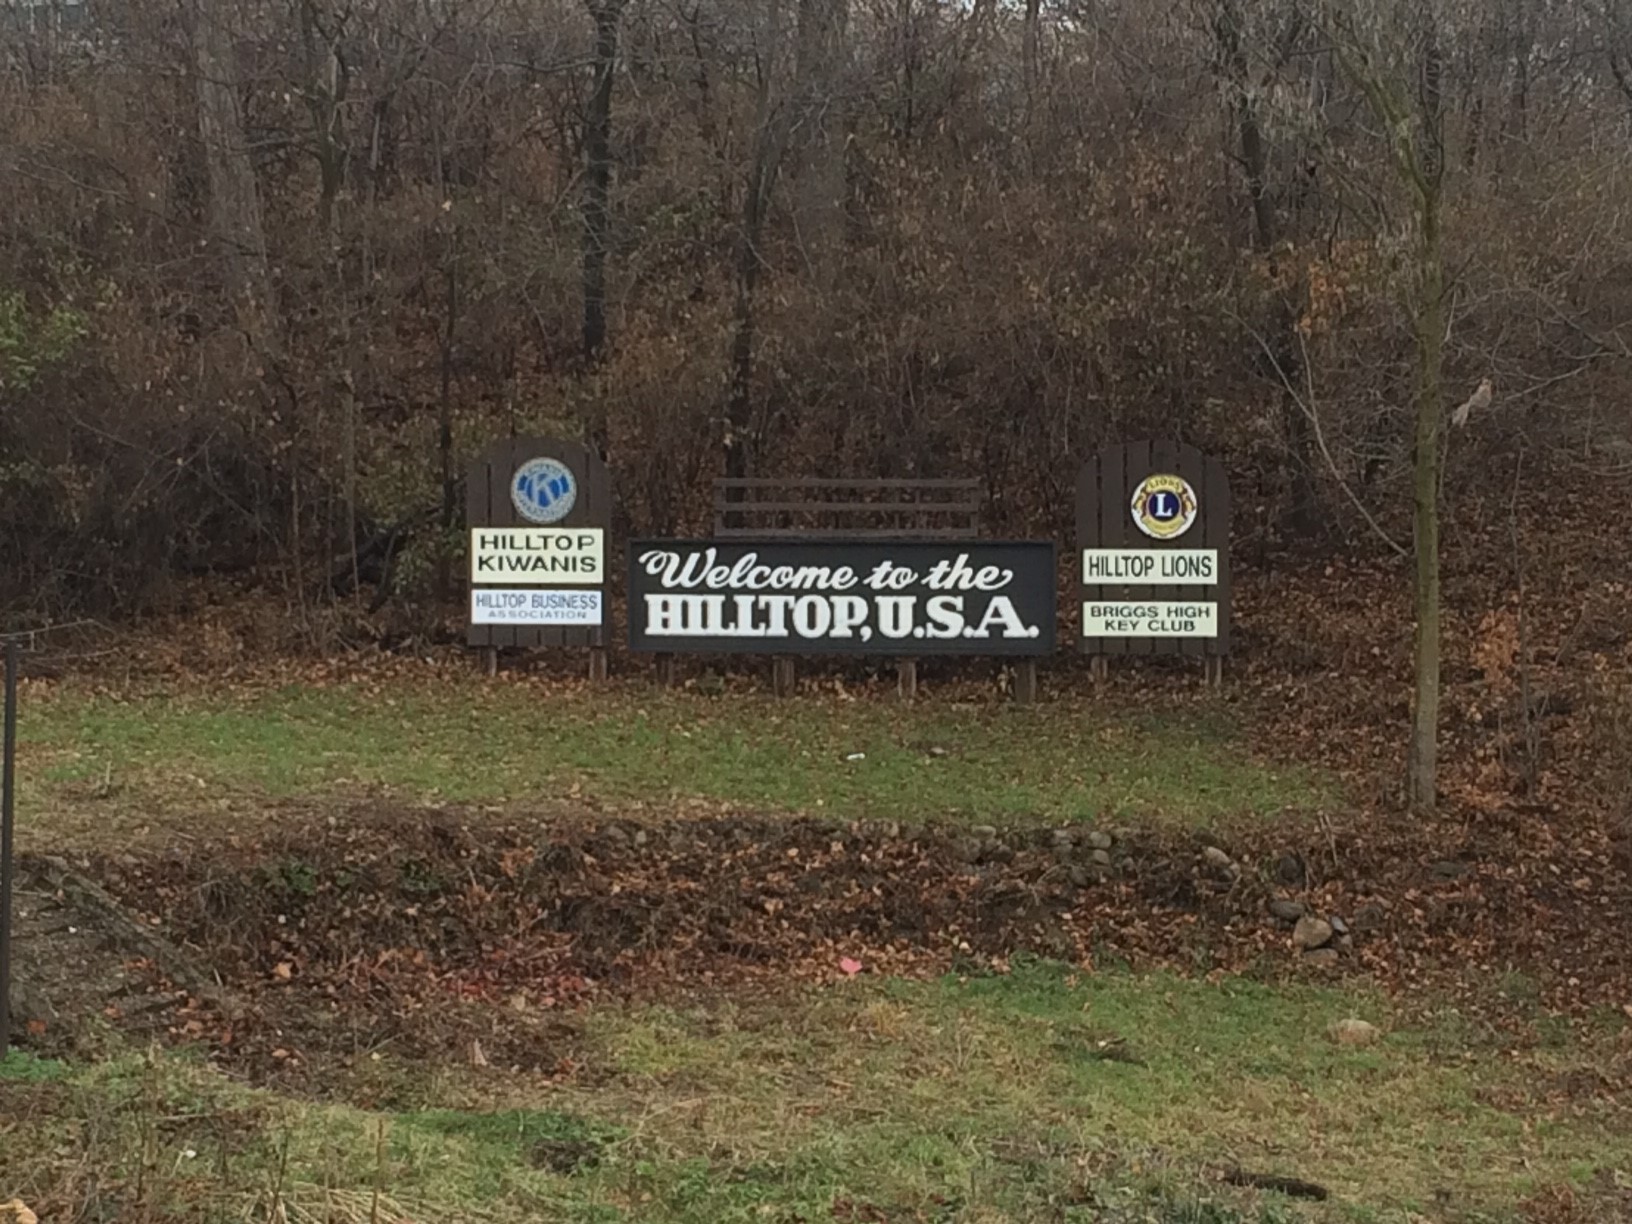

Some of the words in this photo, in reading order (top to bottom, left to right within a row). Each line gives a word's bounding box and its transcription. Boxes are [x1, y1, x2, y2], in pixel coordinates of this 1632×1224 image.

[1155, 493, 1173, 517] L
[480, 535, 596, 551] HILLTOP
[478, 555, 597, 573] KIWANIS
[638, 547, 859, 590] Welcome
[863, 560, 918, 590] to
[921, 553, 1014, 591] the
[1088, 555, 1155, 578] HILLTOP
[1161, 555, 1212, 578] LIONS
[476, 593, 527, 609] HILLTOP
[531, 593, 598, 610] BUSINESS
[488, 610, 588, 620] ASSOCIATION
[874, 595, 1040, 639] U.S.A.
[1090, 605, 1159, 619] BRIGGS
[1166, 605, 1210, 619] HIGH
[1104, 619, 1140, 632] KEY
[1147, 619, 1196, 632] CLUB
